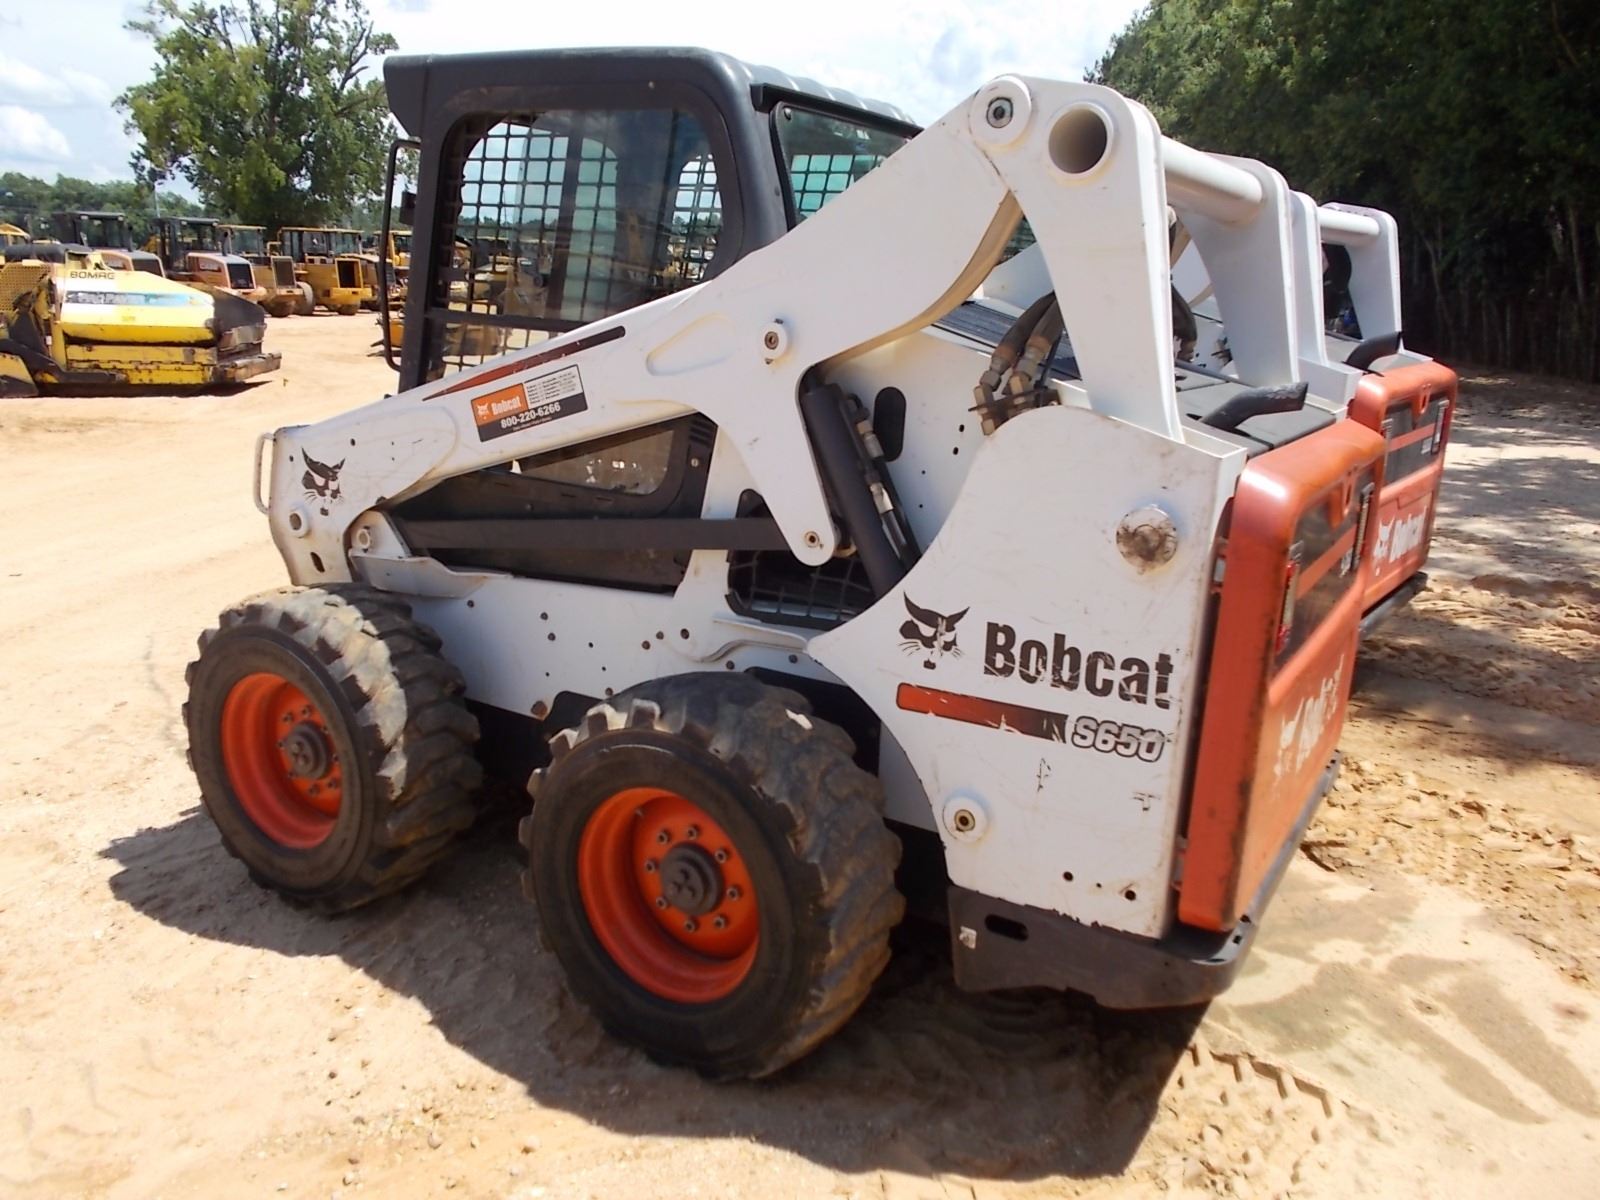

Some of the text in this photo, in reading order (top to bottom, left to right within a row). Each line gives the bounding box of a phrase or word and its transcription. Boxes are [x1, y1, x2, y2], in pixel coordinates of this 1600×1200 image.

[491, 396, 521, 415] Bobcat
[500, 402, 561, 429] 800-220-6266
[983, 621, 1174, 710] Bobcat
[1071, 715, 1166, 763] S650
